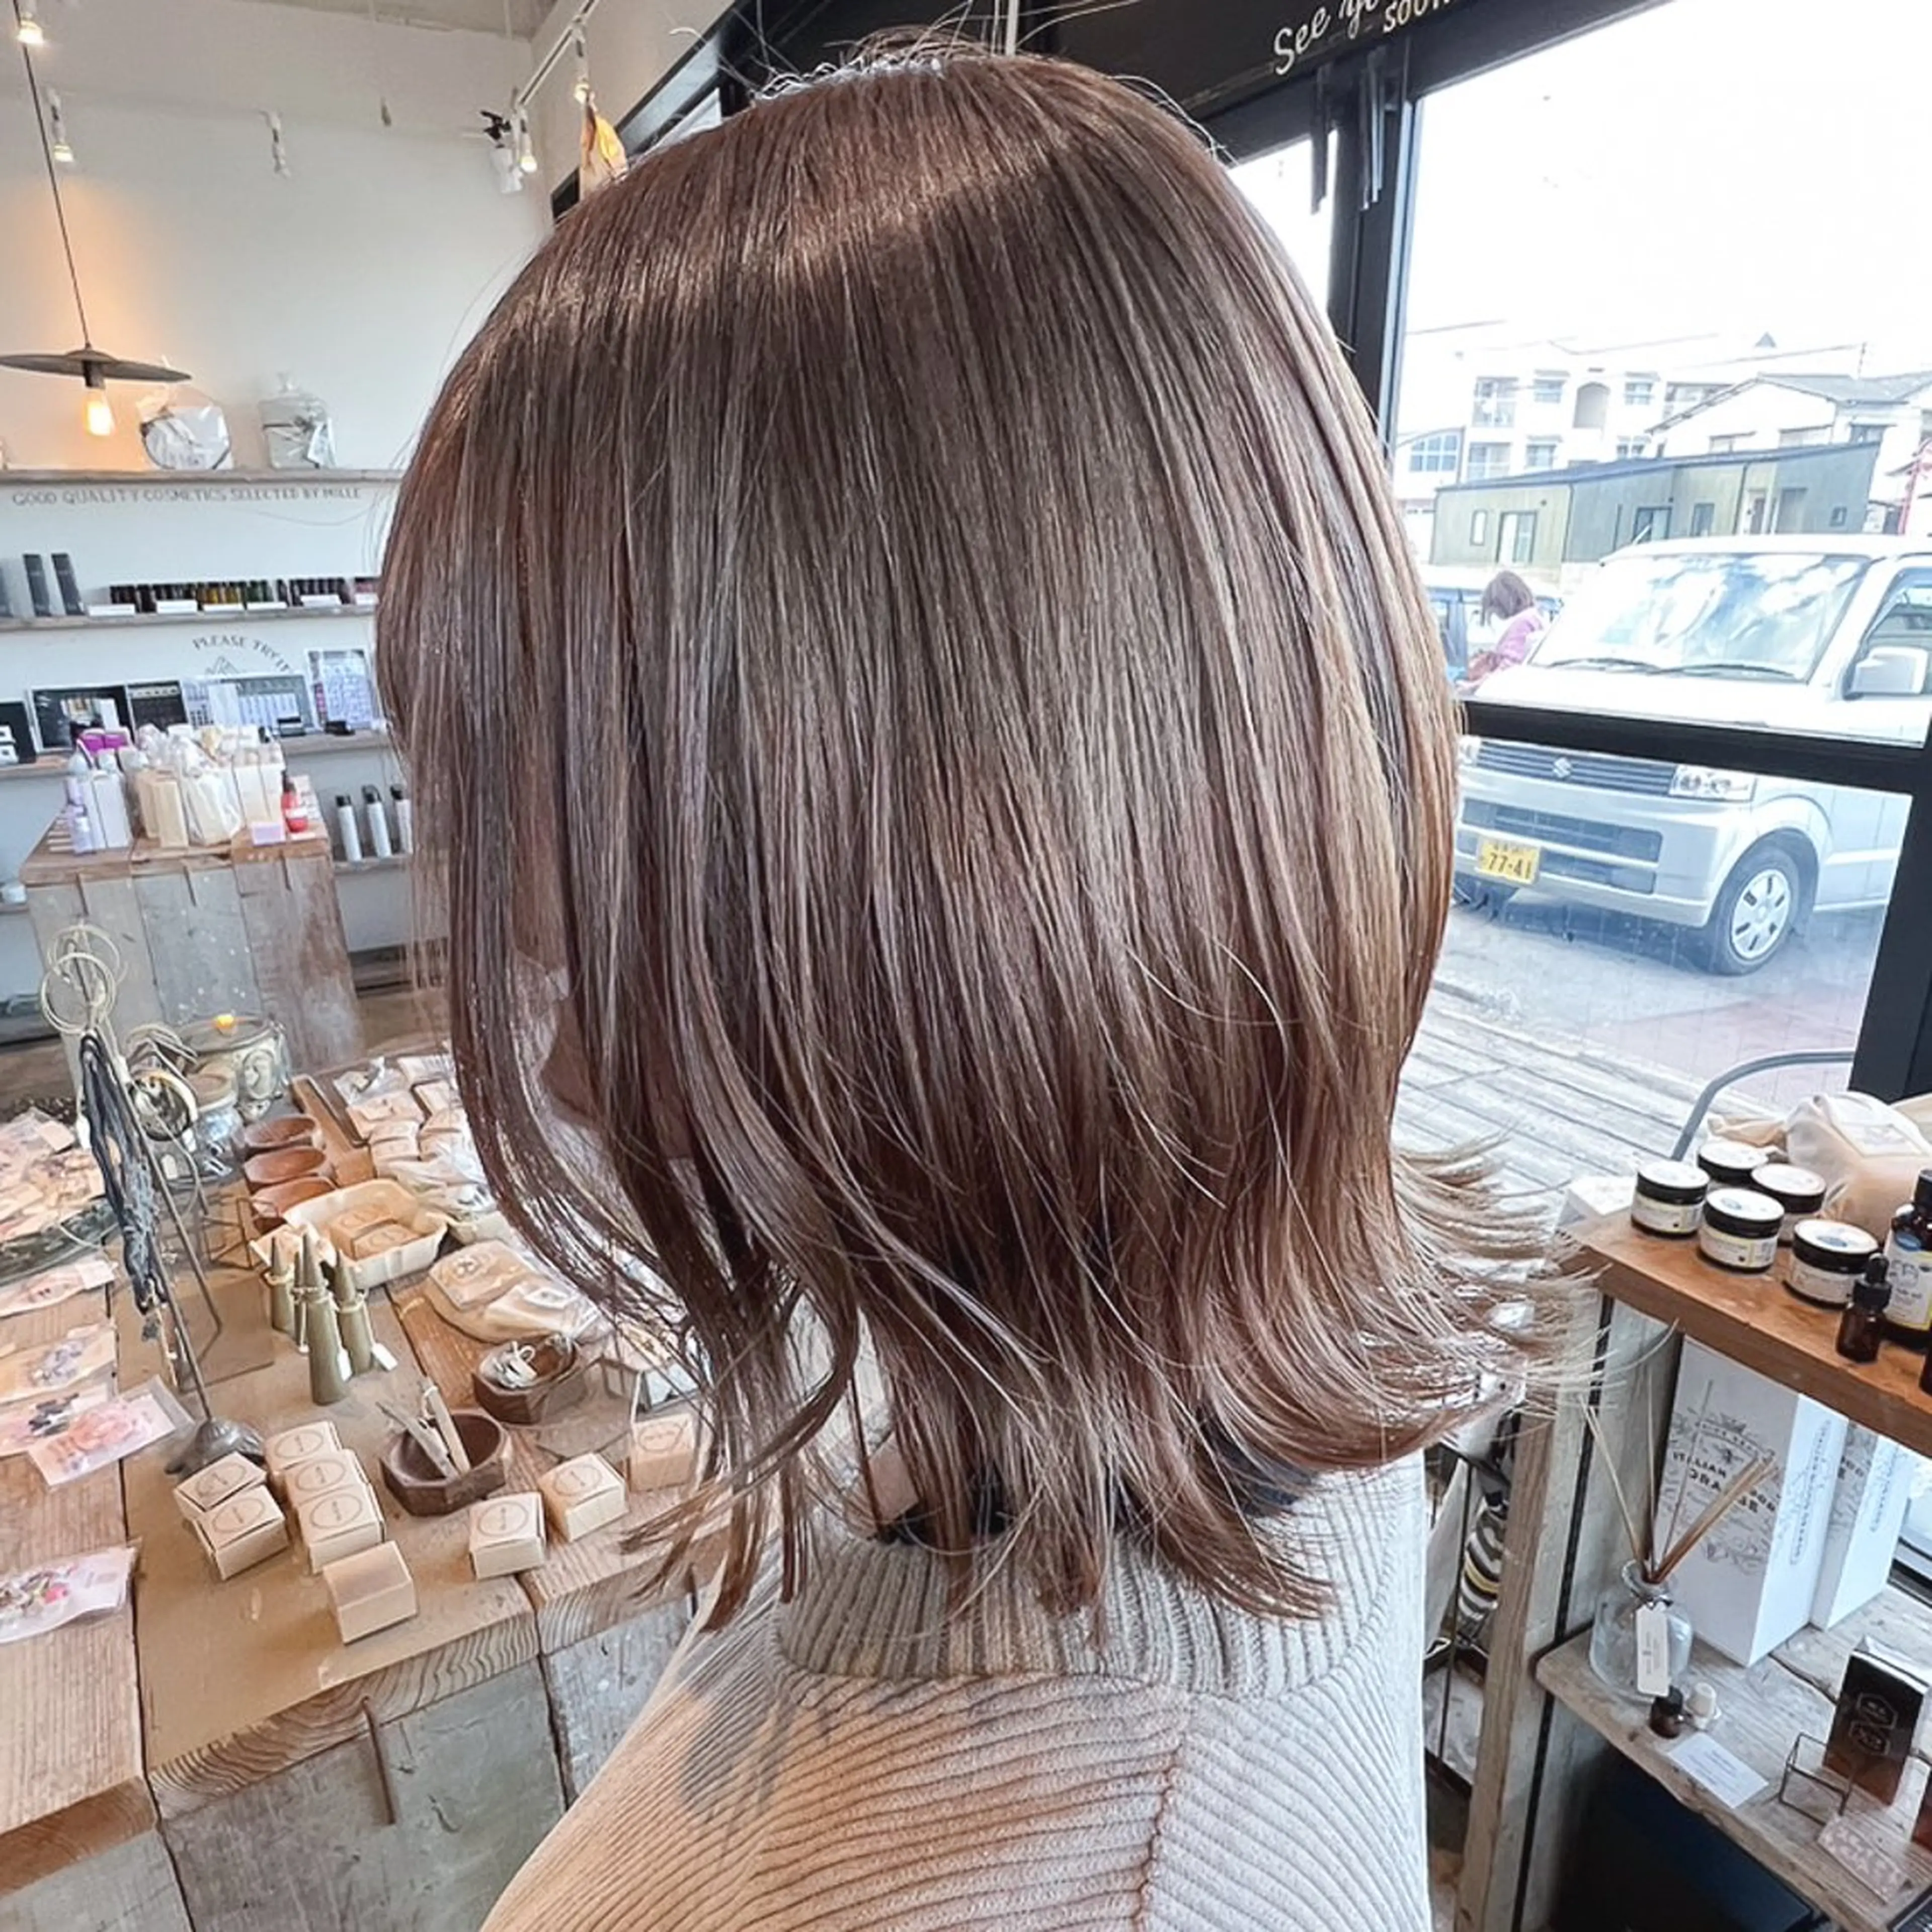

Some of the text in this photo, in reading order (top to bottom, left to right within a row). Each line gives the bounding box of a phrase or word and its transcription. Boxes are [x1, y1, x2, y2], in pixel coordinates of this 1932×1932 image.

[1274, 7, 1331, 75] See
[13, 491, 57, 505] GOOD
[62, 488, 139, 504] QUALITY
[143, 488, 227, 502] COSMETICS
[230, 487, 297, 501] SELECTED
[192, 634, 247, 650] PLEASE
